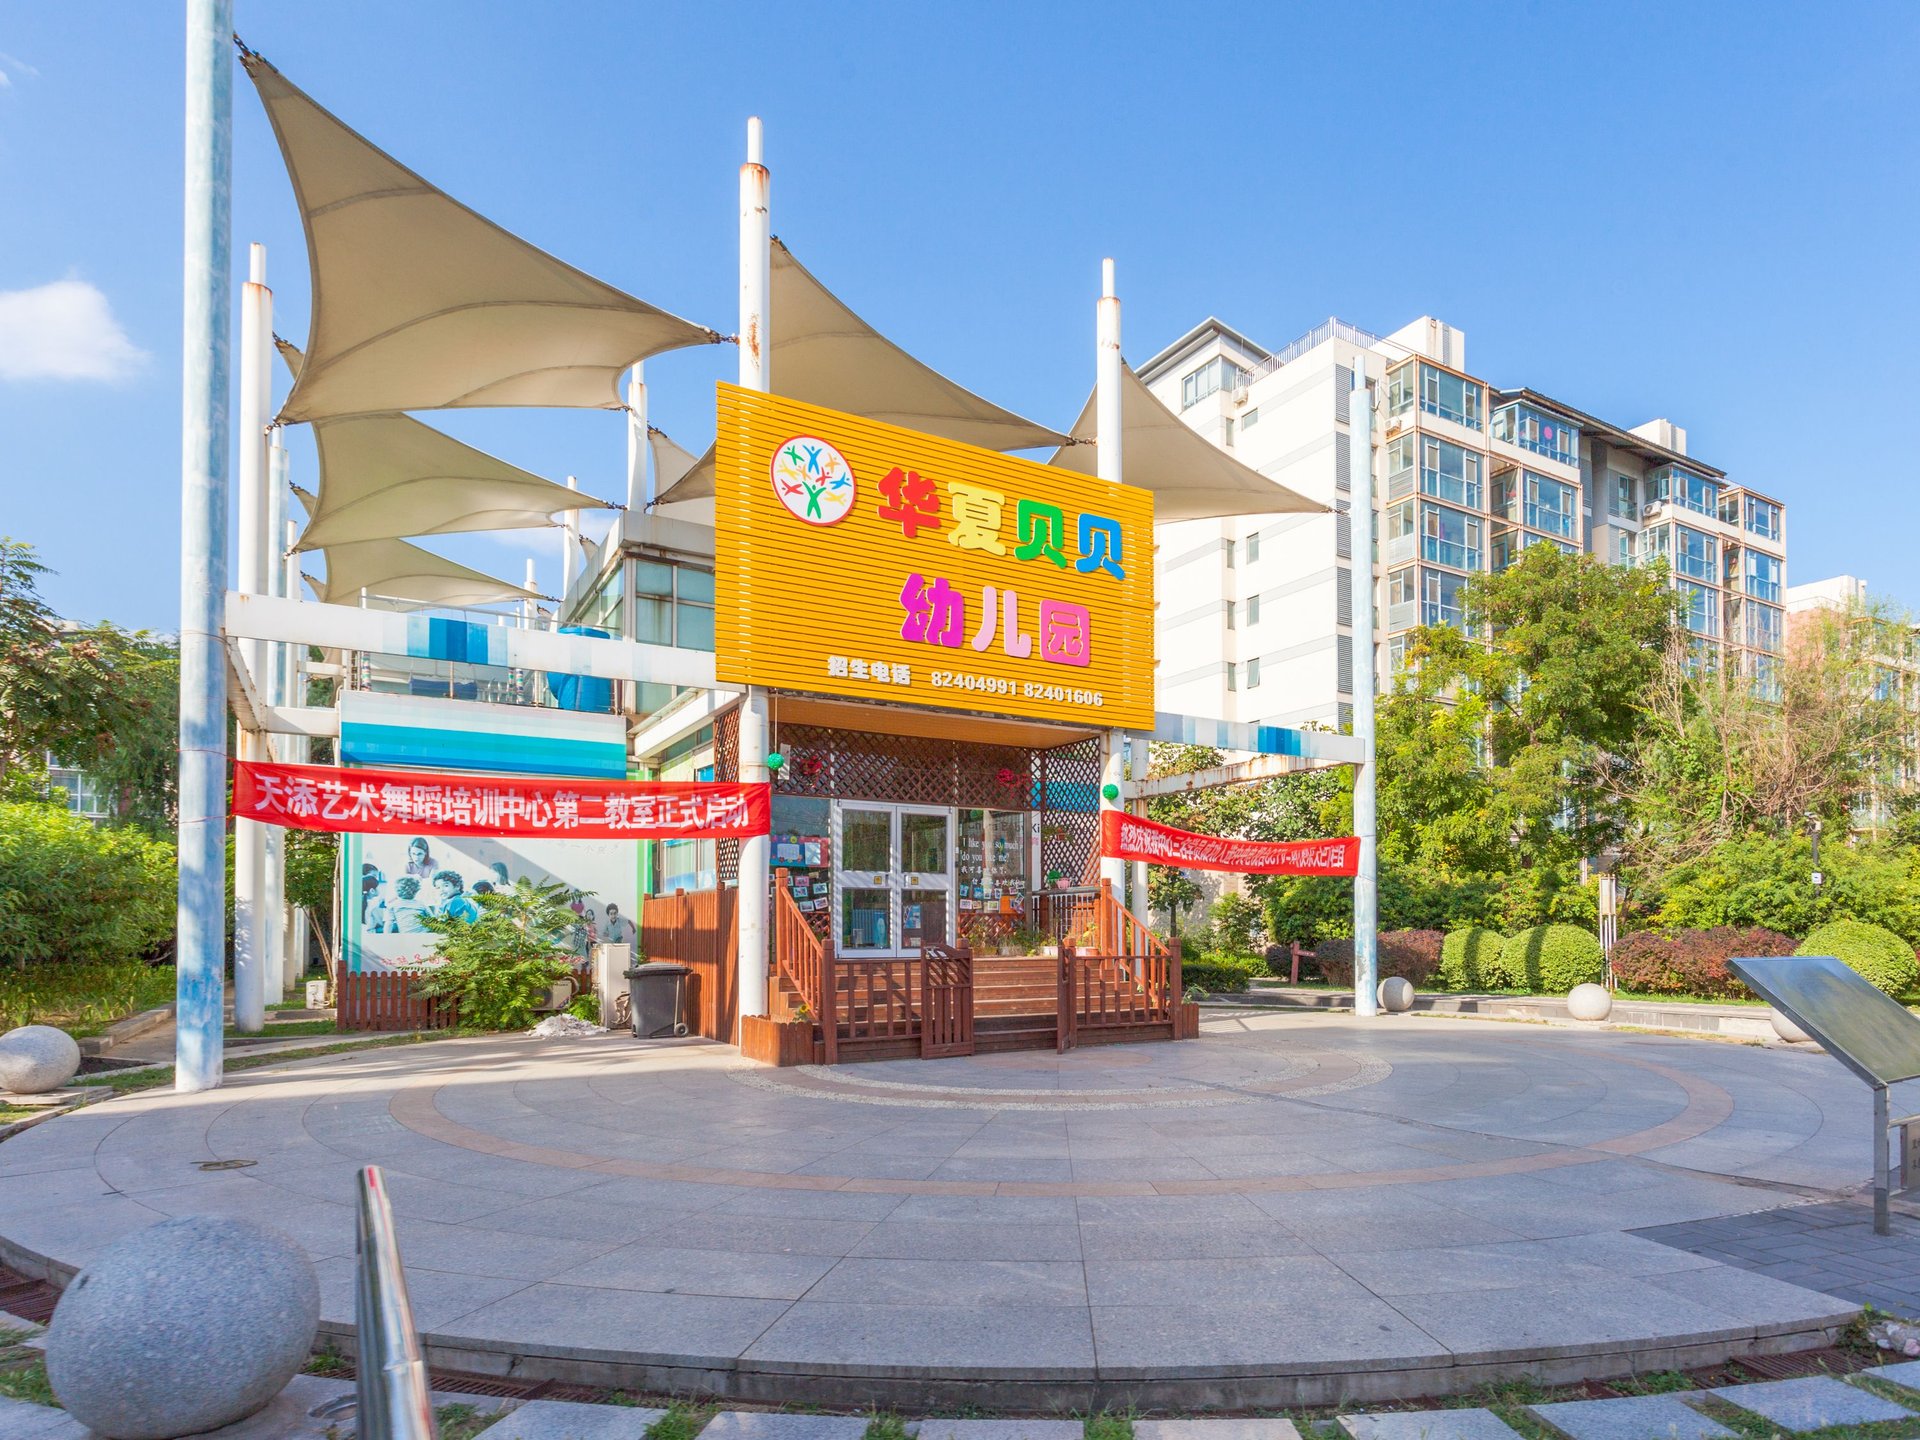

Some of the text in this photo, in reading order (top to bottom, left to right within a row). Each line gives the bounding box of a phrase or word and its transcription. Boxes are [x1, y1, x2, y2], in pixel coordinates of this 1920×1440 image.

[877, 466, 1126, 580] 华夏贝贝
[900, 572, 1091, 667] 幼儿园
[827, 655, 911, 686] 招生电话
[931, 671, 1104, 708] 82404991 82401606
[254, 772, 750, 832] 天添艺术舞蹈培训中心第二教室正式启动
